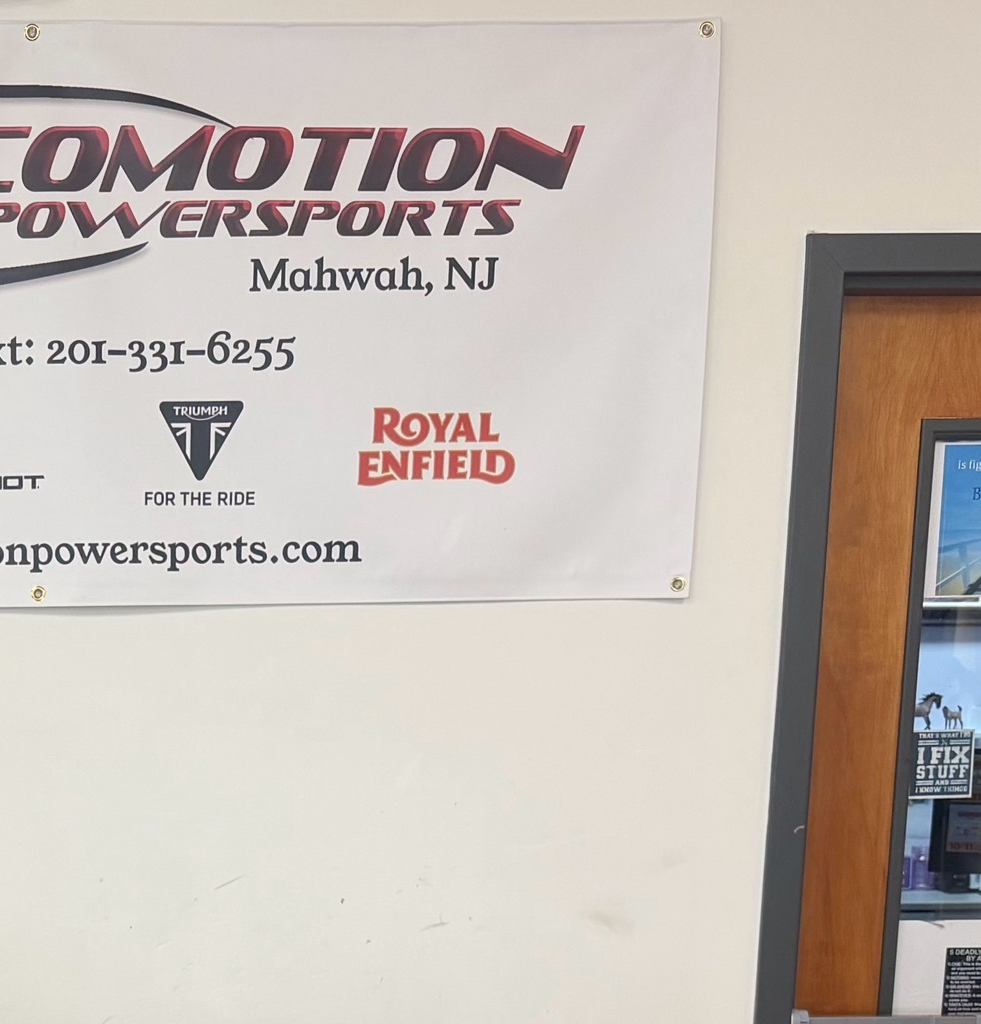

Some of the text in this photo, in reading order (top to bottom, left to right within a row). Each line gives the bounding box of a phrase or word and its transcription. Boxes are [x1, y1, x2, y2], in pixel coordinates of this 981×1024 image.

[250, 256, 499, 296] Mahwah, NJ
[47, 331, 296, 372] 201-331-6255
[172, 405, 228, 418] TRIUMPH
[373, 407, 500, 447] ROYAL
[357, 449, 516, 486] ENFIELD
[144, 491, 255, 506] FOR THE RIDE
[917, 745, 970, 765] I FIX
[915, 764, 969, 780] STUFF
